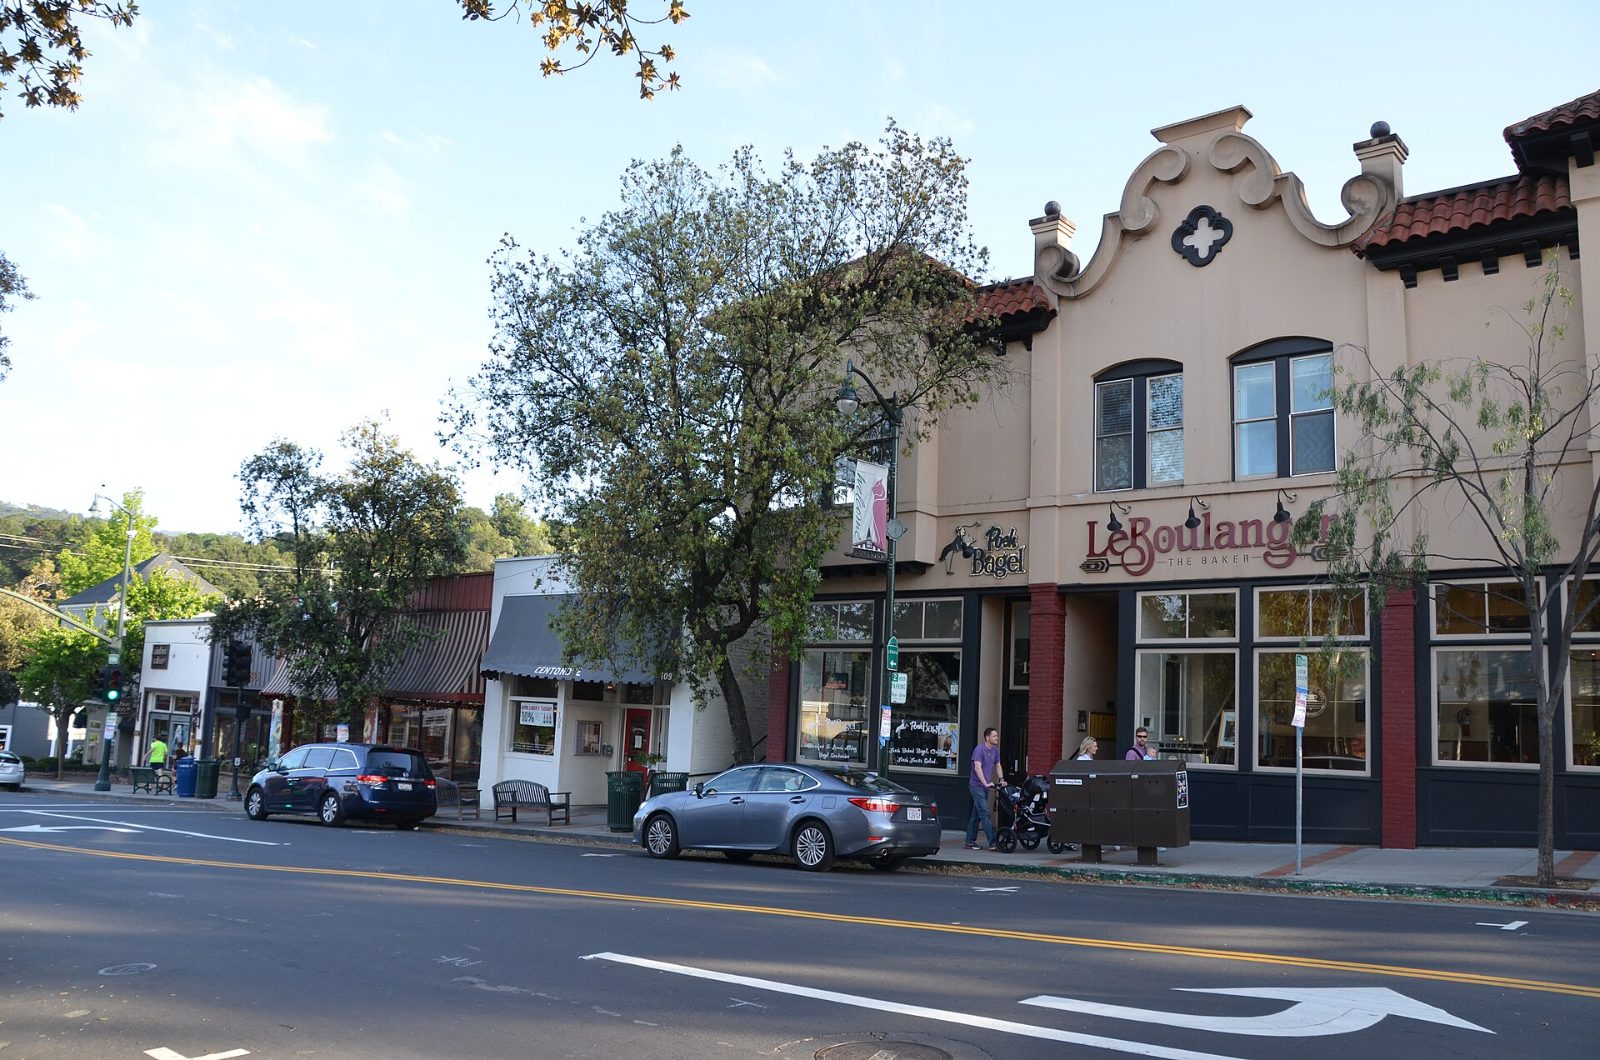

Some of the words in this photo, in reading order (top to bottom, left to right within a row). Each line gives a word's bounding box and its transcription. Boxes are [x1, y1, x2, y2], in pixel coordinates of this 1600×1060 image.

[1087, 511, 1340, 576] LeBoulangr
[969, 545, 1026, 579] Bagel
[1168, 557, 1193, 567] THE
[1201, 554, 1250, 565] BAKER
[534, 666, 583, 677] CENTONOE
[893, 673, 898, 681] 2
